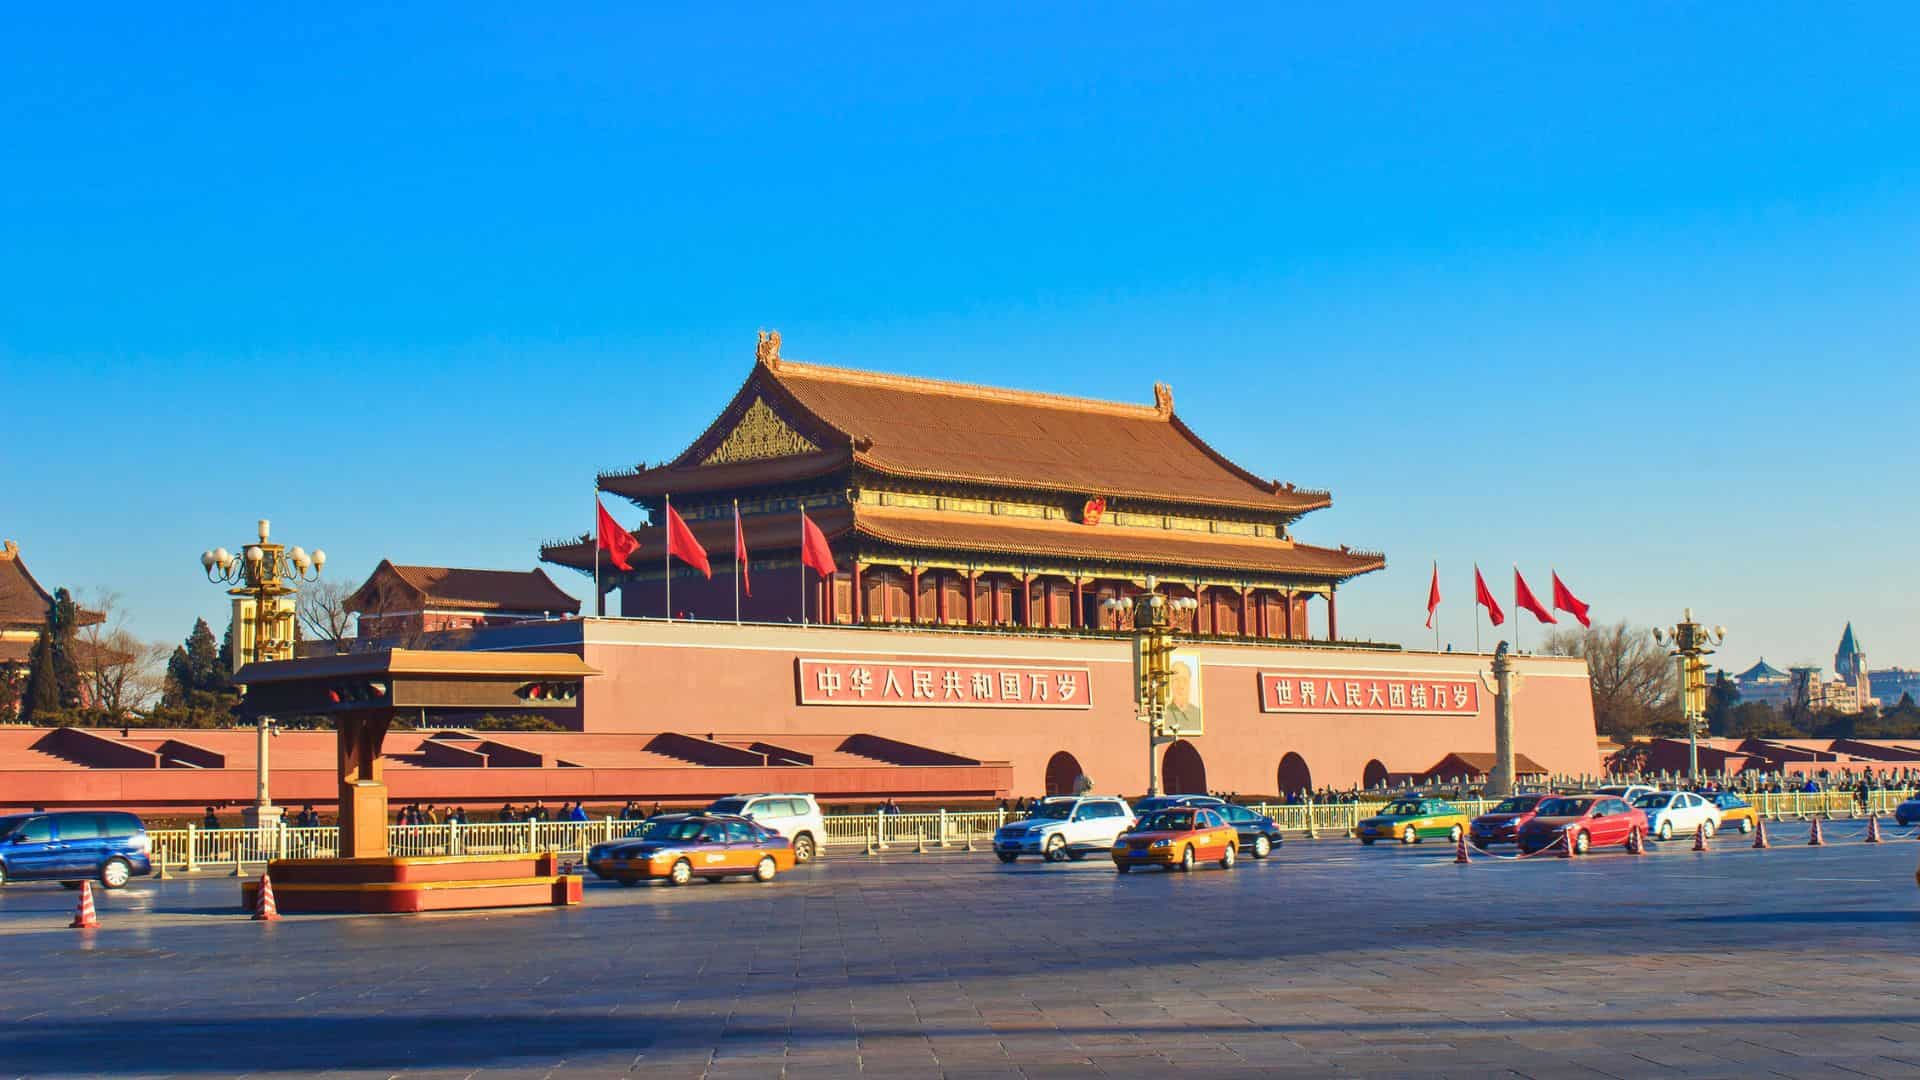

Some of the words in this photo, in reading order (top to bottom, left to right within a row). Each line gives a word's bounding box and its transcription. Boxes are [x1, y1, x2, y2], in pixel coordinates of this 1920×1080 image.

[817, 667, 1077, 701] 中华人民共和国万岁
[1275, 680, 1468, 709] 世界人民大团结万岁
